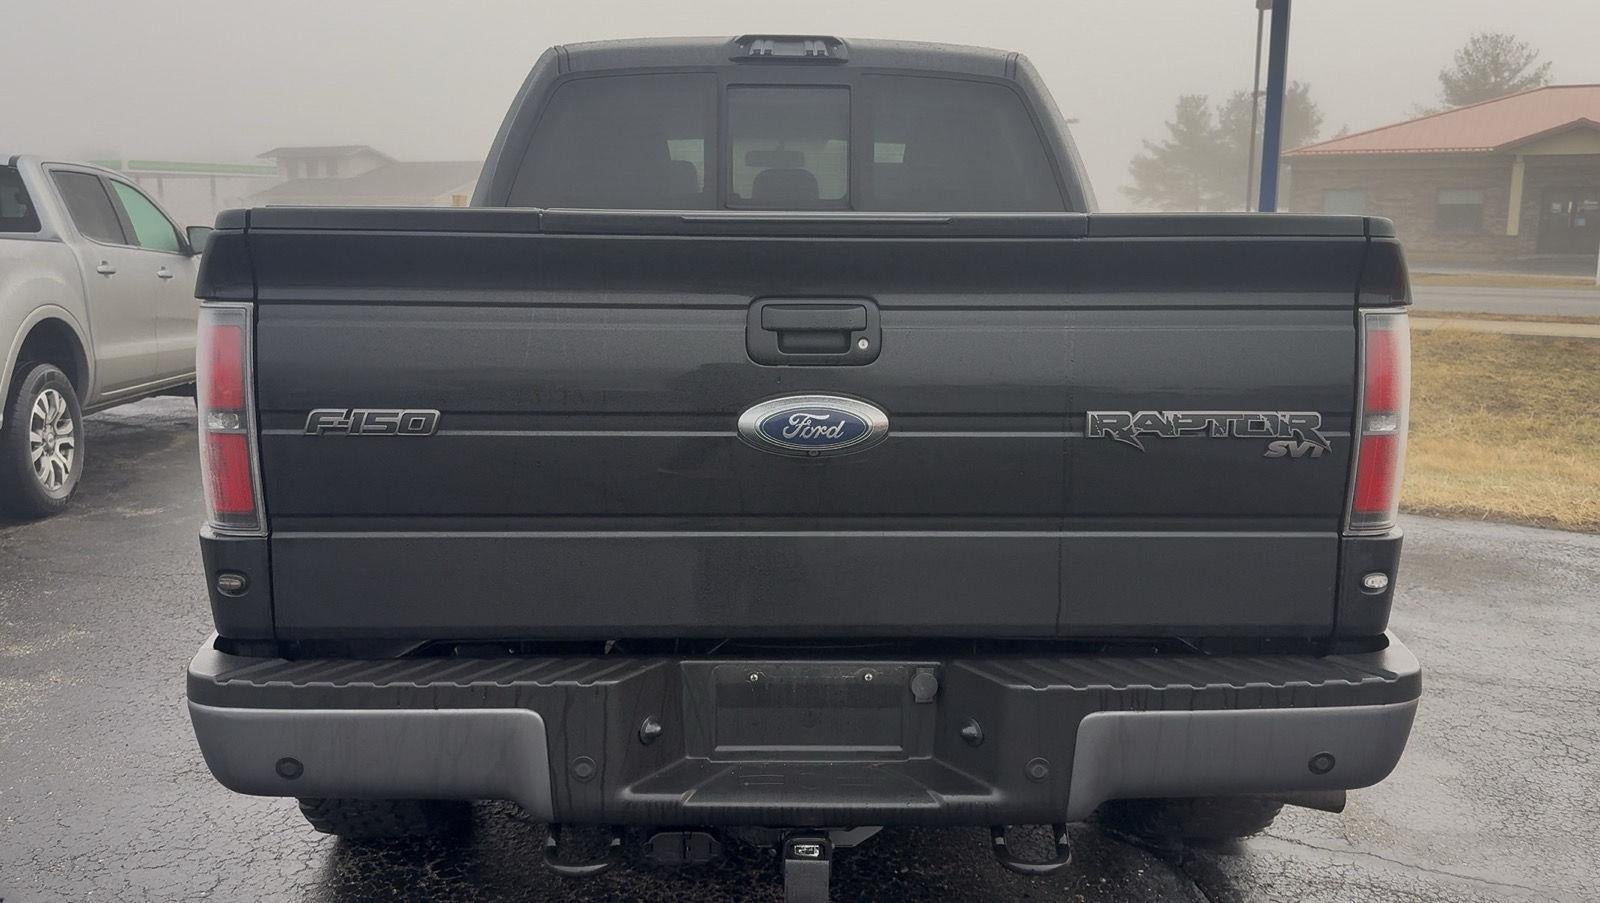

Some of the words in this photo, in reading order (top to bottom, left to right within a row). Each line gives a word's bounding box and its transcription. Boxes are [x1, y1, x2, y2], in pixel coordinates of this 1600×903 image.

[304, 408, 441, 436] F-150
[782, 413, 846, 439] Ford
[1086, 410, 1332, 453] RAPTOR
[1264, 440, 1327, 458] SVT
